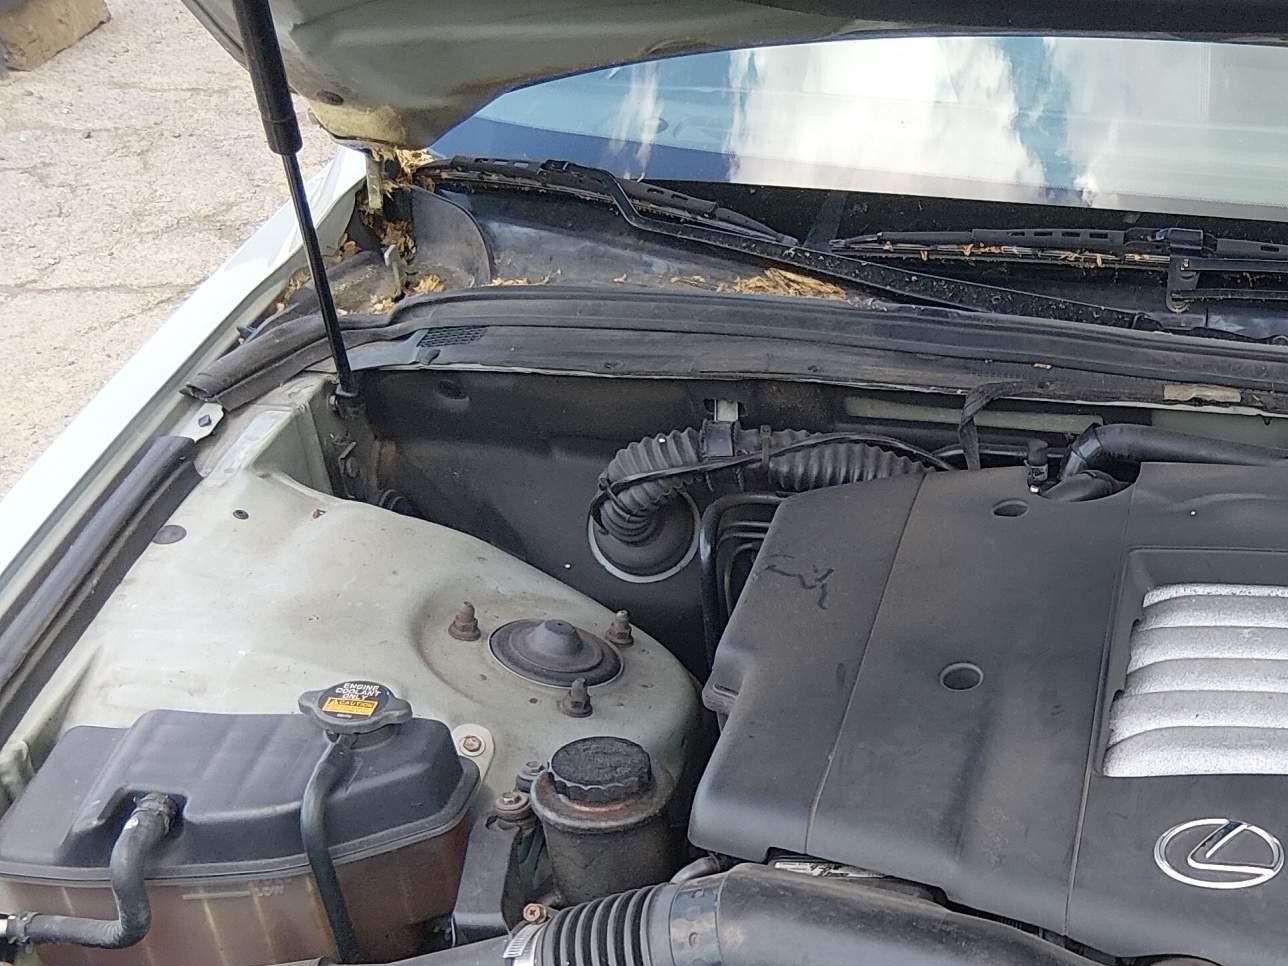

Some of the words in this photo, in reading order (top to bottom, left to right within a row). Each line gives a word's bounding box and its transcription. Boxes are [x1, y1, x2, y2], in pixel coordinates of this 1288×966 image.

[343, 682, 380, 690] ENGINE
[336, 687, 381, 697] COOLANT
[338, 700, 374, 708] CAUTION
